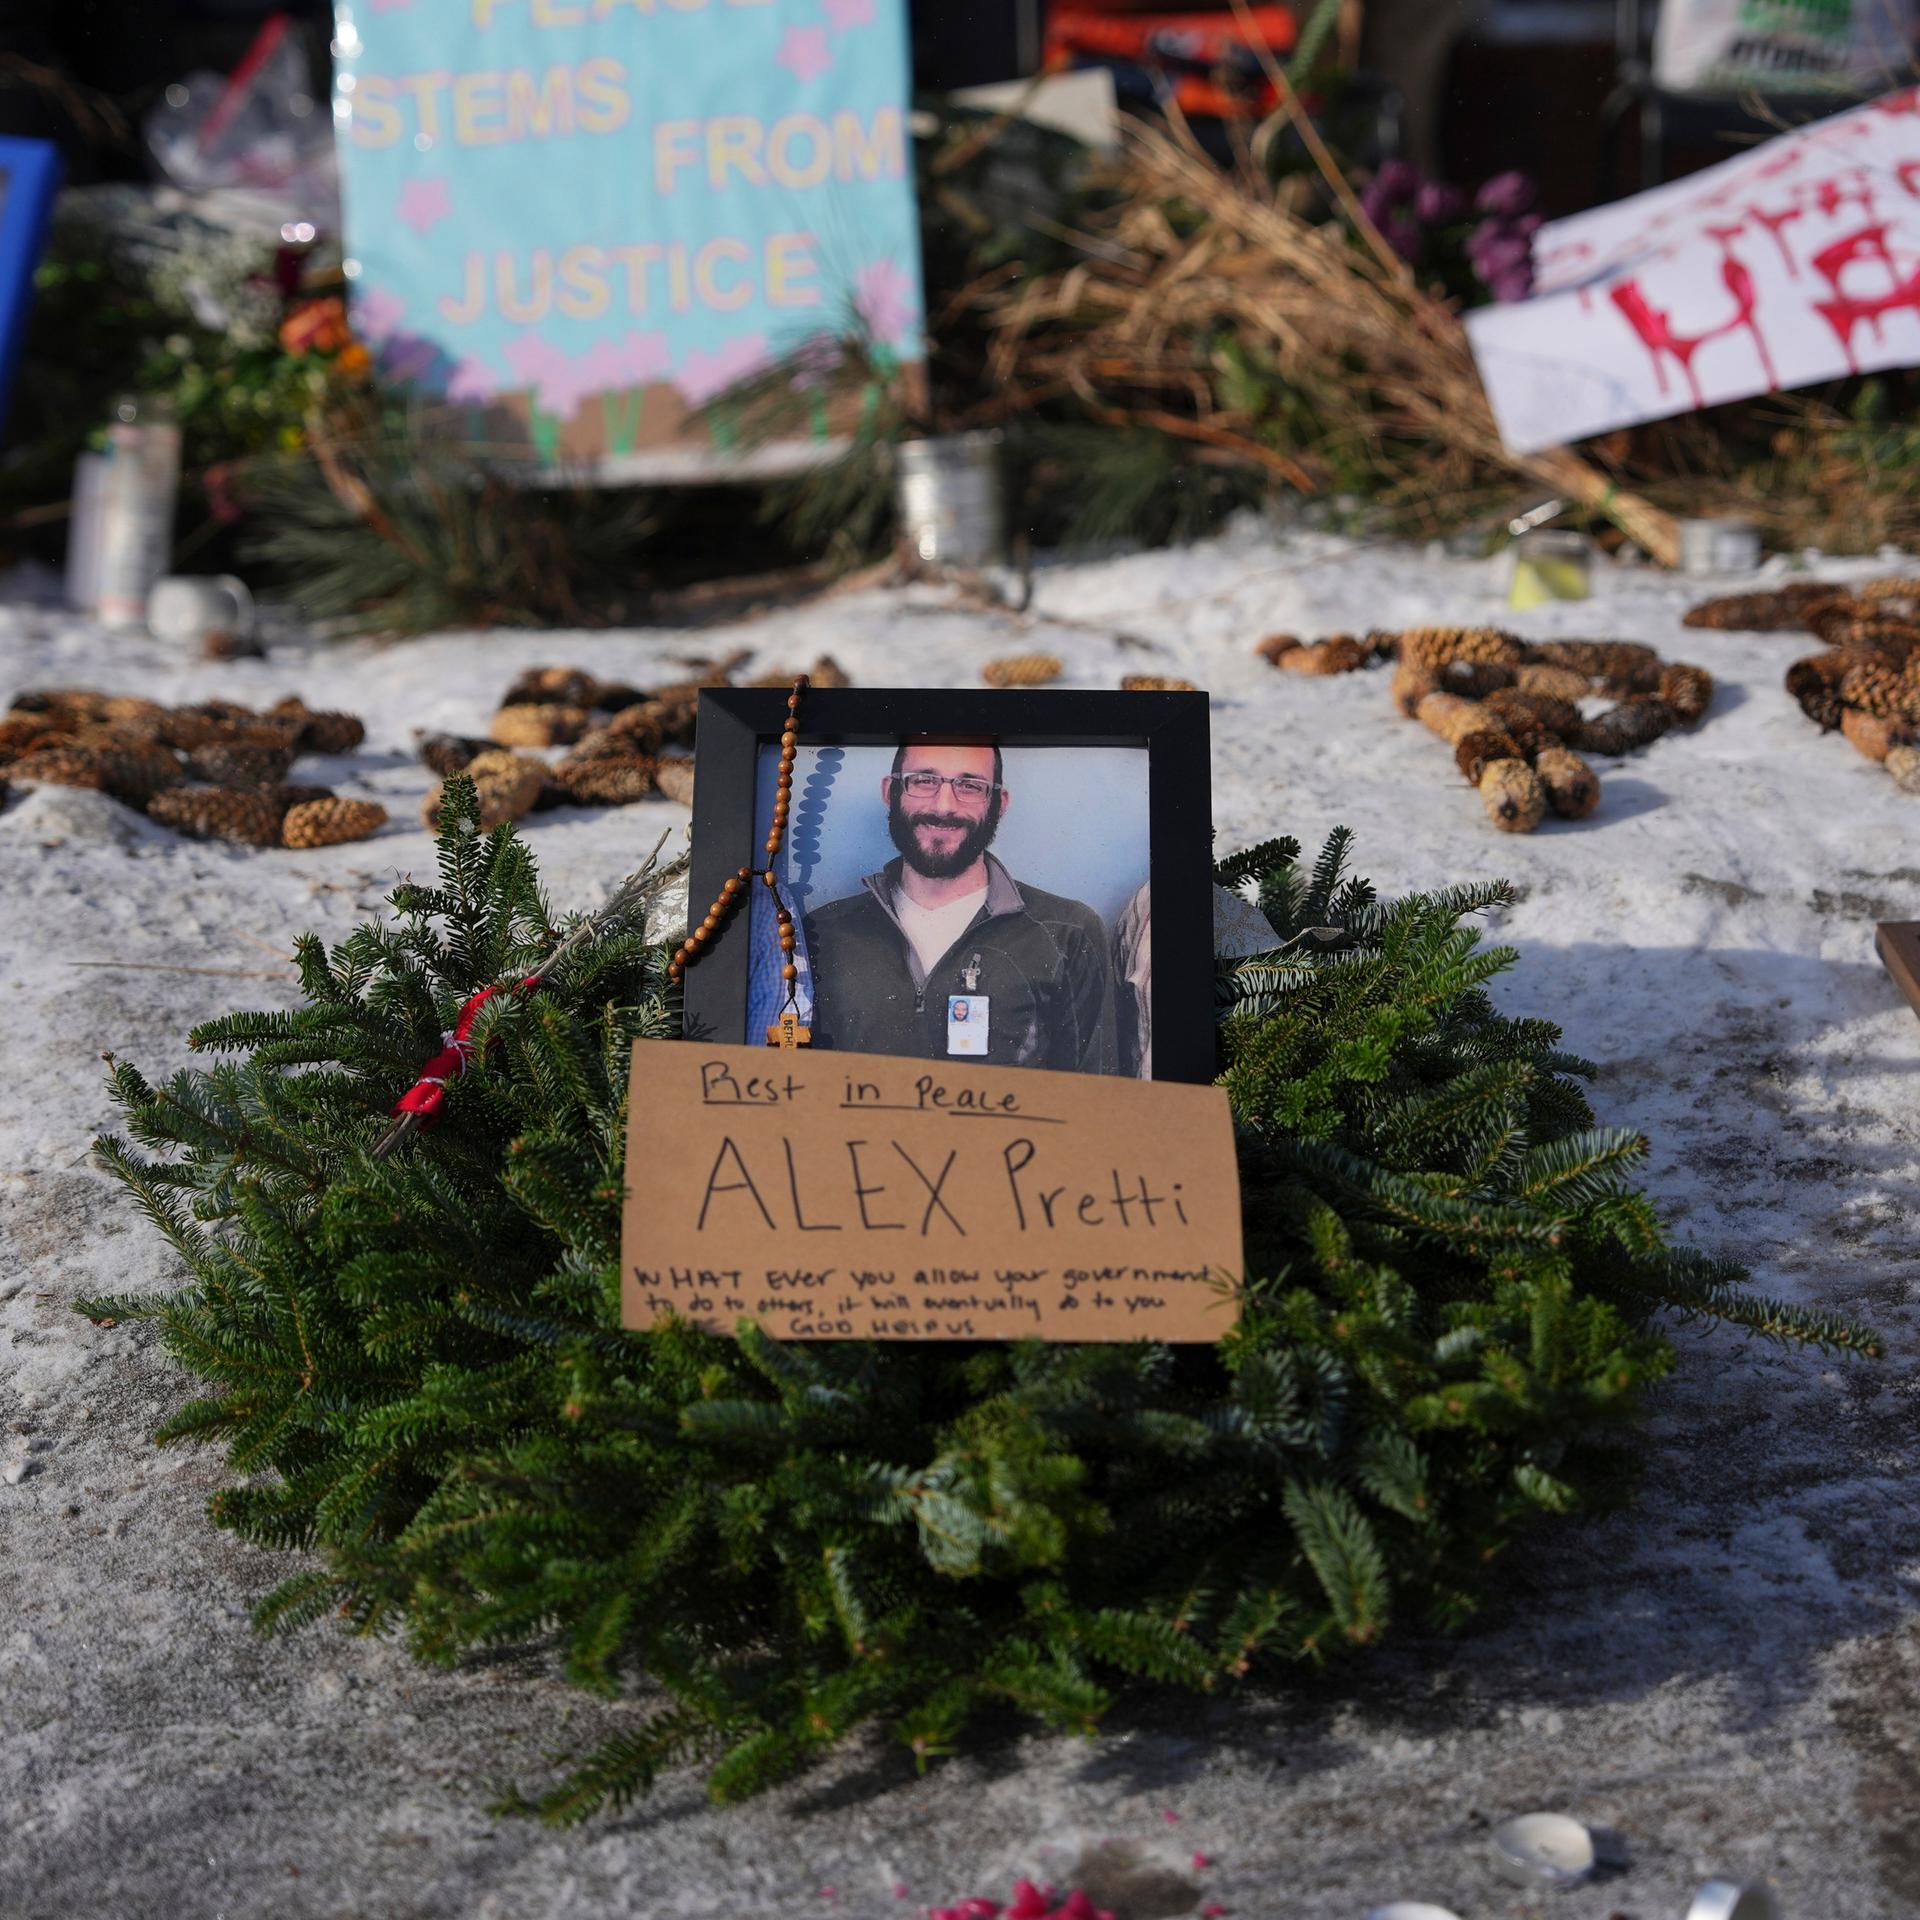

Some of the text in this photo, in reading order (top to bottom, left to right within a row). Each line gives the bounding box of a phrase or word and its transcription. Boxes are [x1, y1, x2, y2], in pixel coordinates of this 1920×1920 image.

[349, 57, 633, 149] STEMS
[652, 106, 906, 194] FROM
[440, 232, 823, 325] JUSTICE
[701, 1061, 805, 1101] Rest
[845, 1076, 881, 1101] in
[697, 1136, 1189, 1237] ALEX Pretti
[633, 1266, 743, 1289] WHAT
[850, 1270, 896, 1291] you
[914, 1267, 980, 1285] allow
[994, 1268, 1049, 1292] your
[1063, 1265, 1209, 1289] government
[646, 1293, 675, 1312] to
[689, 1293, 714, 1312] do
[725, 1296, 745, 1310] to
[839, 1296, 862, 1314] it
[1093, 1292, 1115, 1309] to
[1124, 1294, 1166, 1313] you
